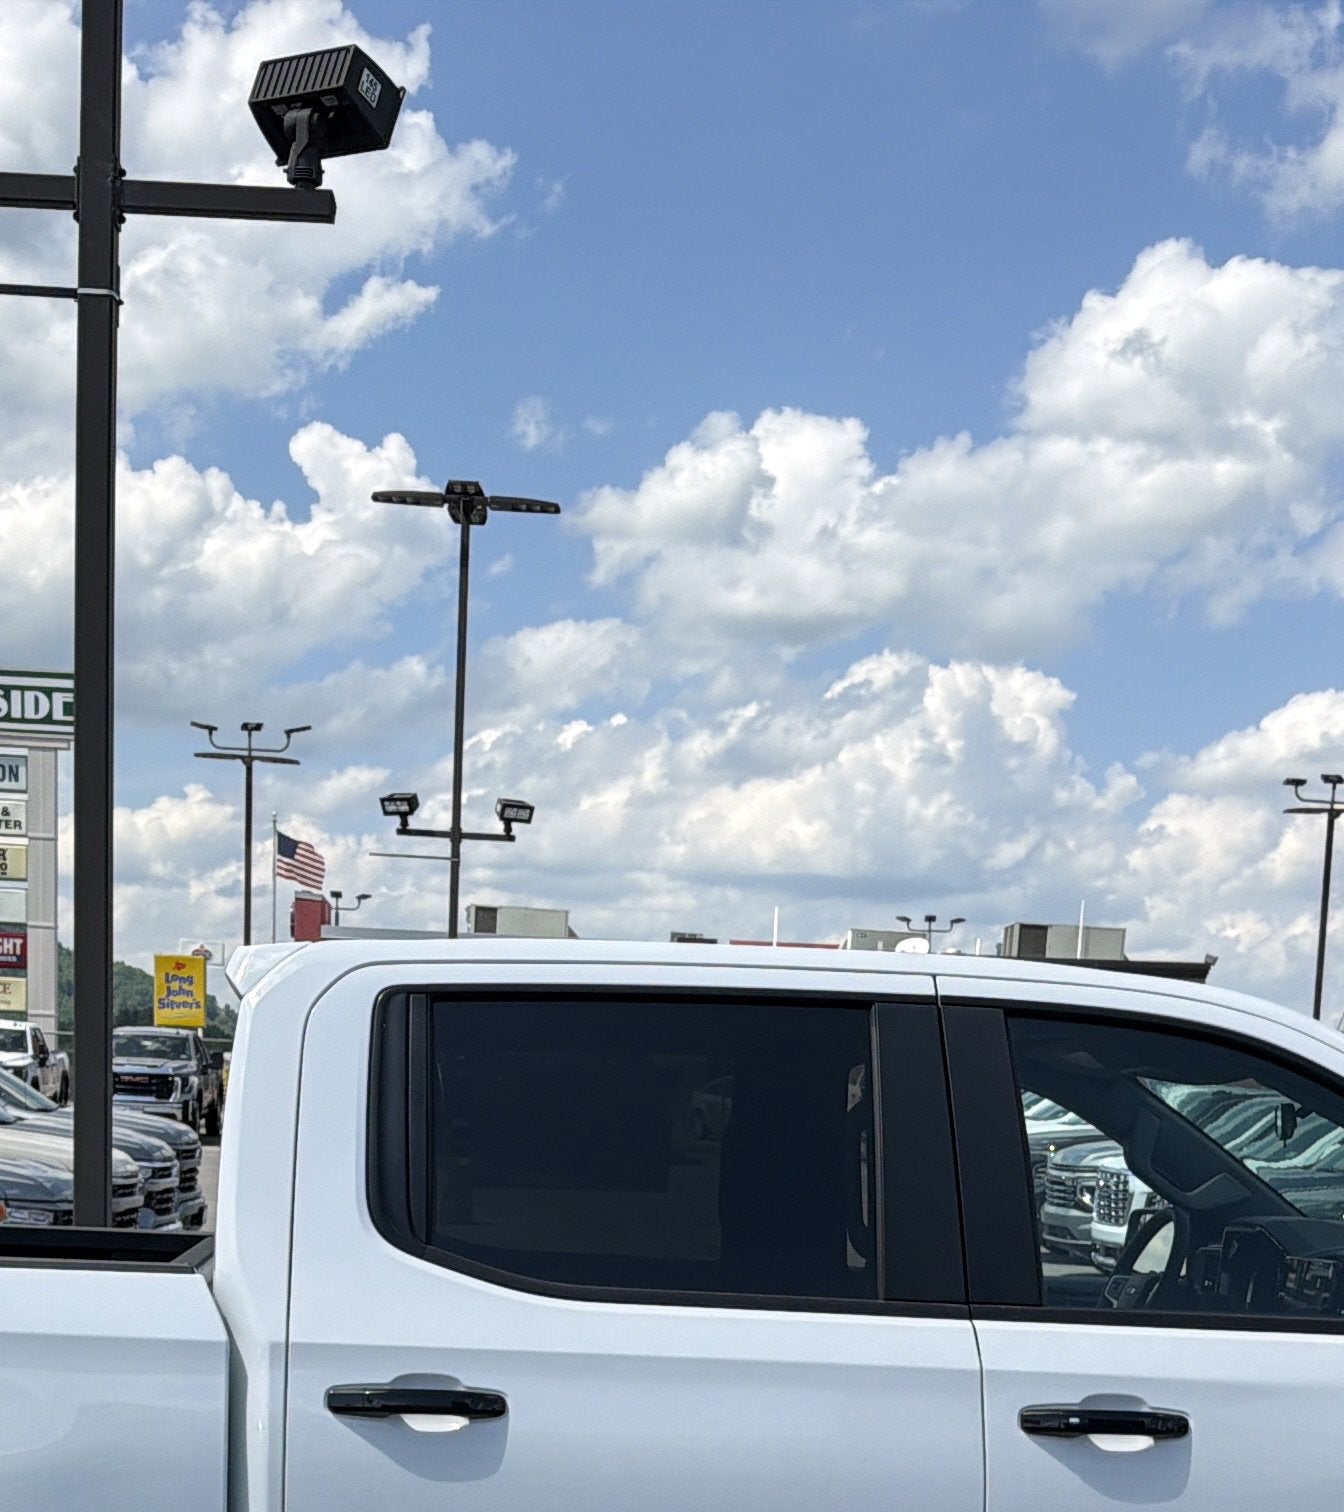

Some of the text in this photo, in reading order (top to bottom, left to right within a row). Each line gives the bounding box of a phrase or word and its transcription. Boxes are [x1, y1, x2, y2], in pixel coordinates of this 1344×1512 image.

[0, 806, 11, 817] &
[165, 972, 194, 985] Long
[165, 985, 194, 999] John
